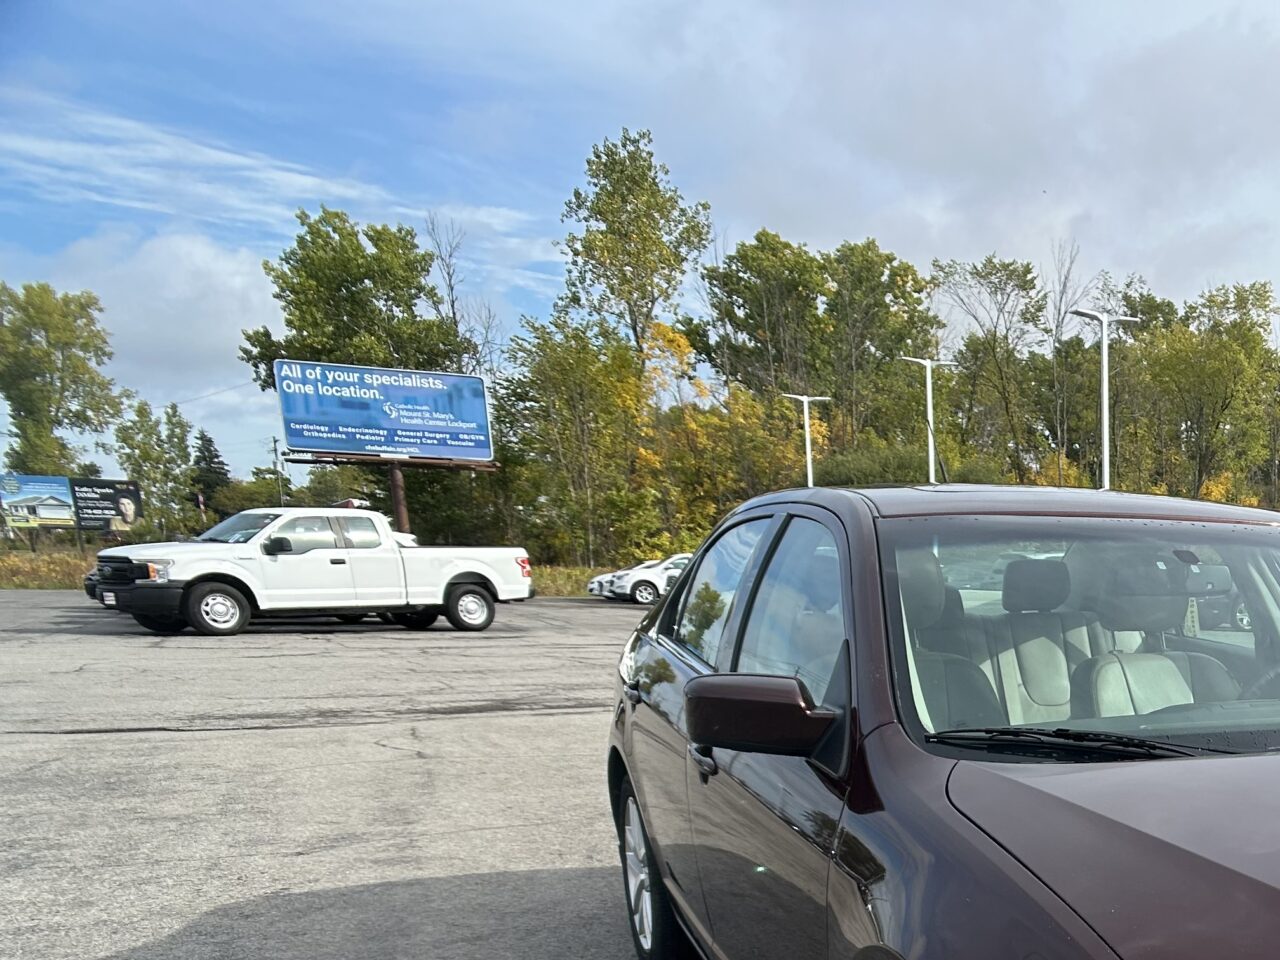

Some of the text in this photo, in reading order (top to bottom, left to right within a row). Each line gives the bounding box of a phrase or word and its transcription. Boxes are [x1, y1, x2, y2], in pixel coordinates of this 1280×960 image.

[281, 364, 448, 390] All of your specialists.
[282, 380, 384, 400] One location.
[400, 409, 422, 418] Mount
[400, 417, 478, 429] Health Center Lockport
[290, 422, 329, 432] Cardiology
[338, 426, 388, 437] Endocrinology
[396, 429, 423, 438] General
[424, 431, 450, 440] Surgery
[394, 436, 421, 445] Primary
[421, 437, 438, 445] Care
[446, 438, 475, 447] Vascular
